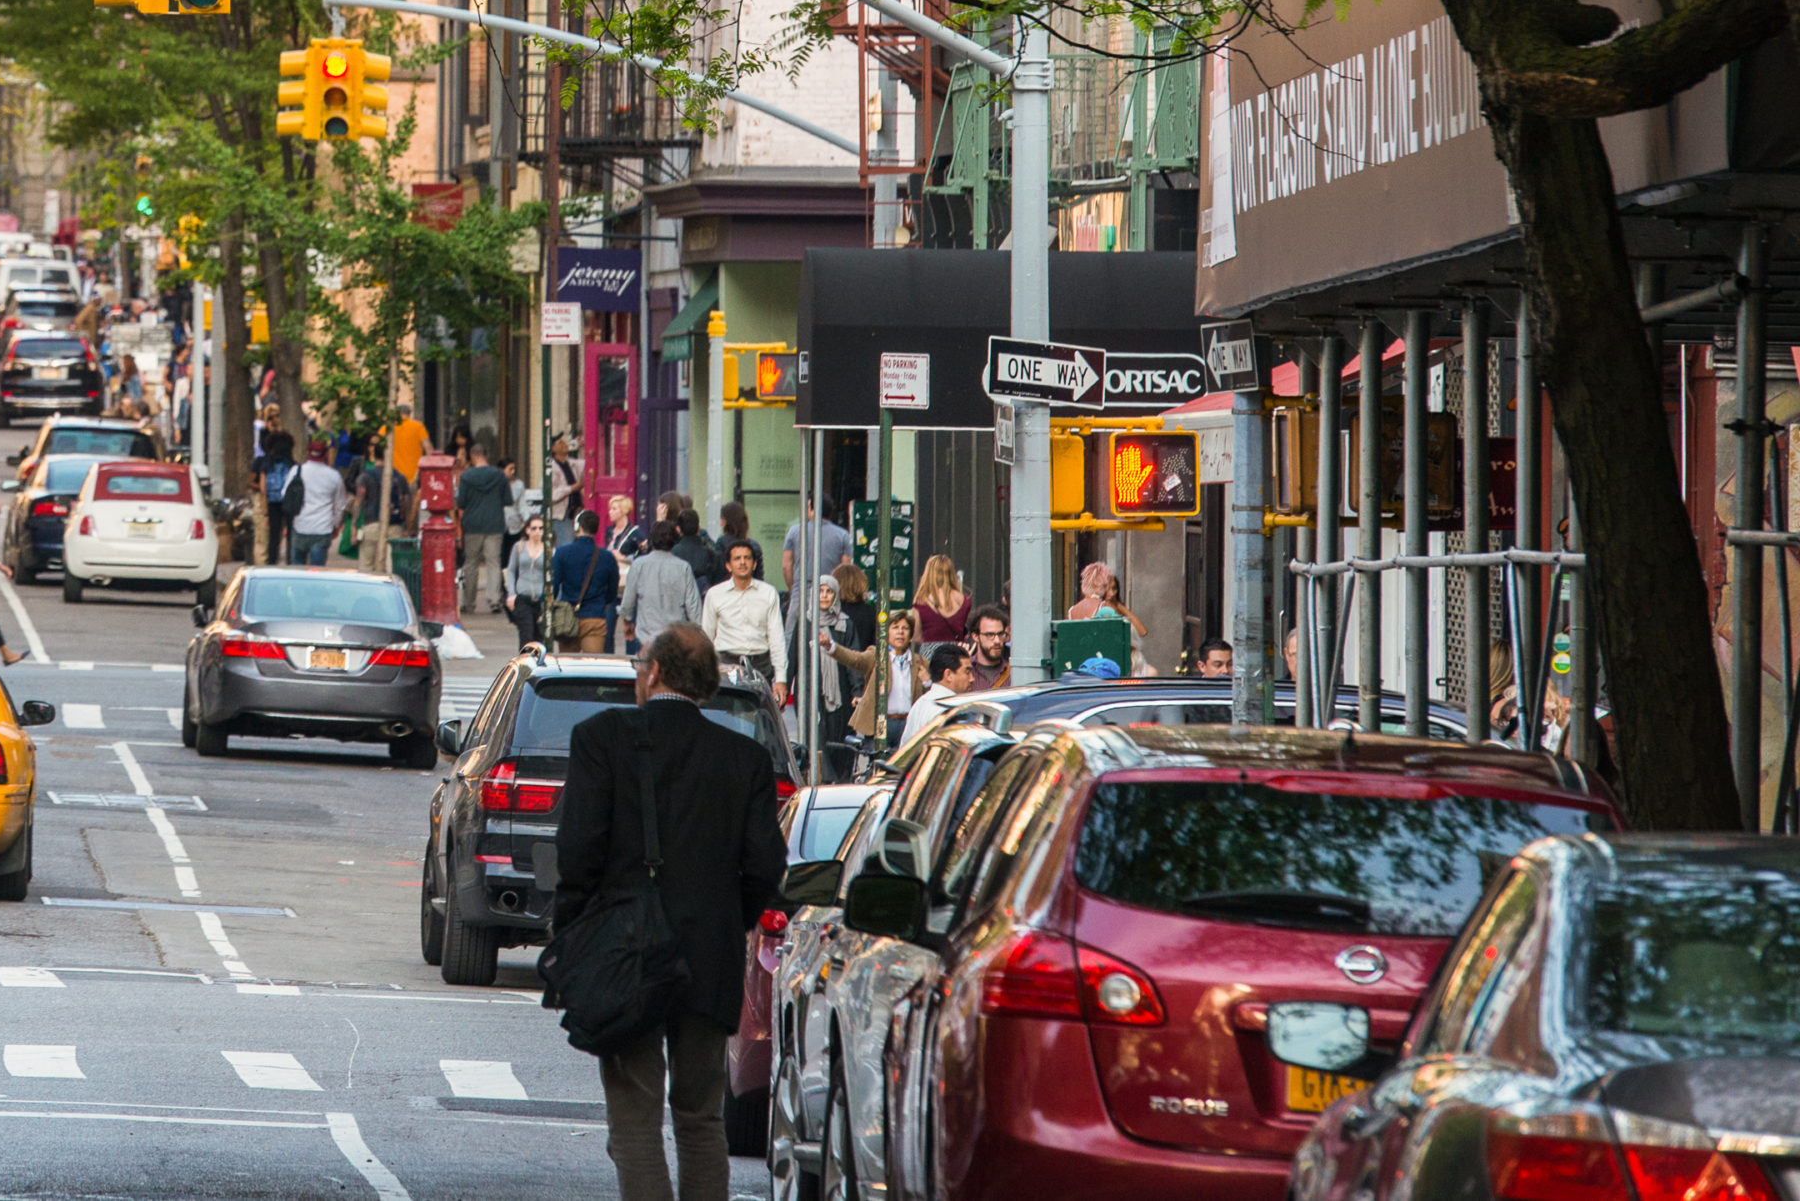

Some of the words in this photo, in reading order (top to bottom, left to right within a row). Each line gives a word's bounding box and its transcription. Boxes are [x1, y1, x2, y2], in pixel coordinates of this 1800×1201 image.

[1257, 73, 1319, 204] FLAGSHIP
[1323, 53, 1367, 184] STAND
[1371, 29, 1419, 167] ALONE
[557, 261, 637, 297] jeremy
[883, 360, 891, 368] NO
[893, 360, 917, 369] PARKING
[1212, 346, 1227, 371] ONE
[1231, 342, 1248, 369] WAY
[1007, 358, 1042, 382] ONE
[1057, 363, 1089, 388] WAY
[1149, 1095, 1230, 1117] ROGUE
